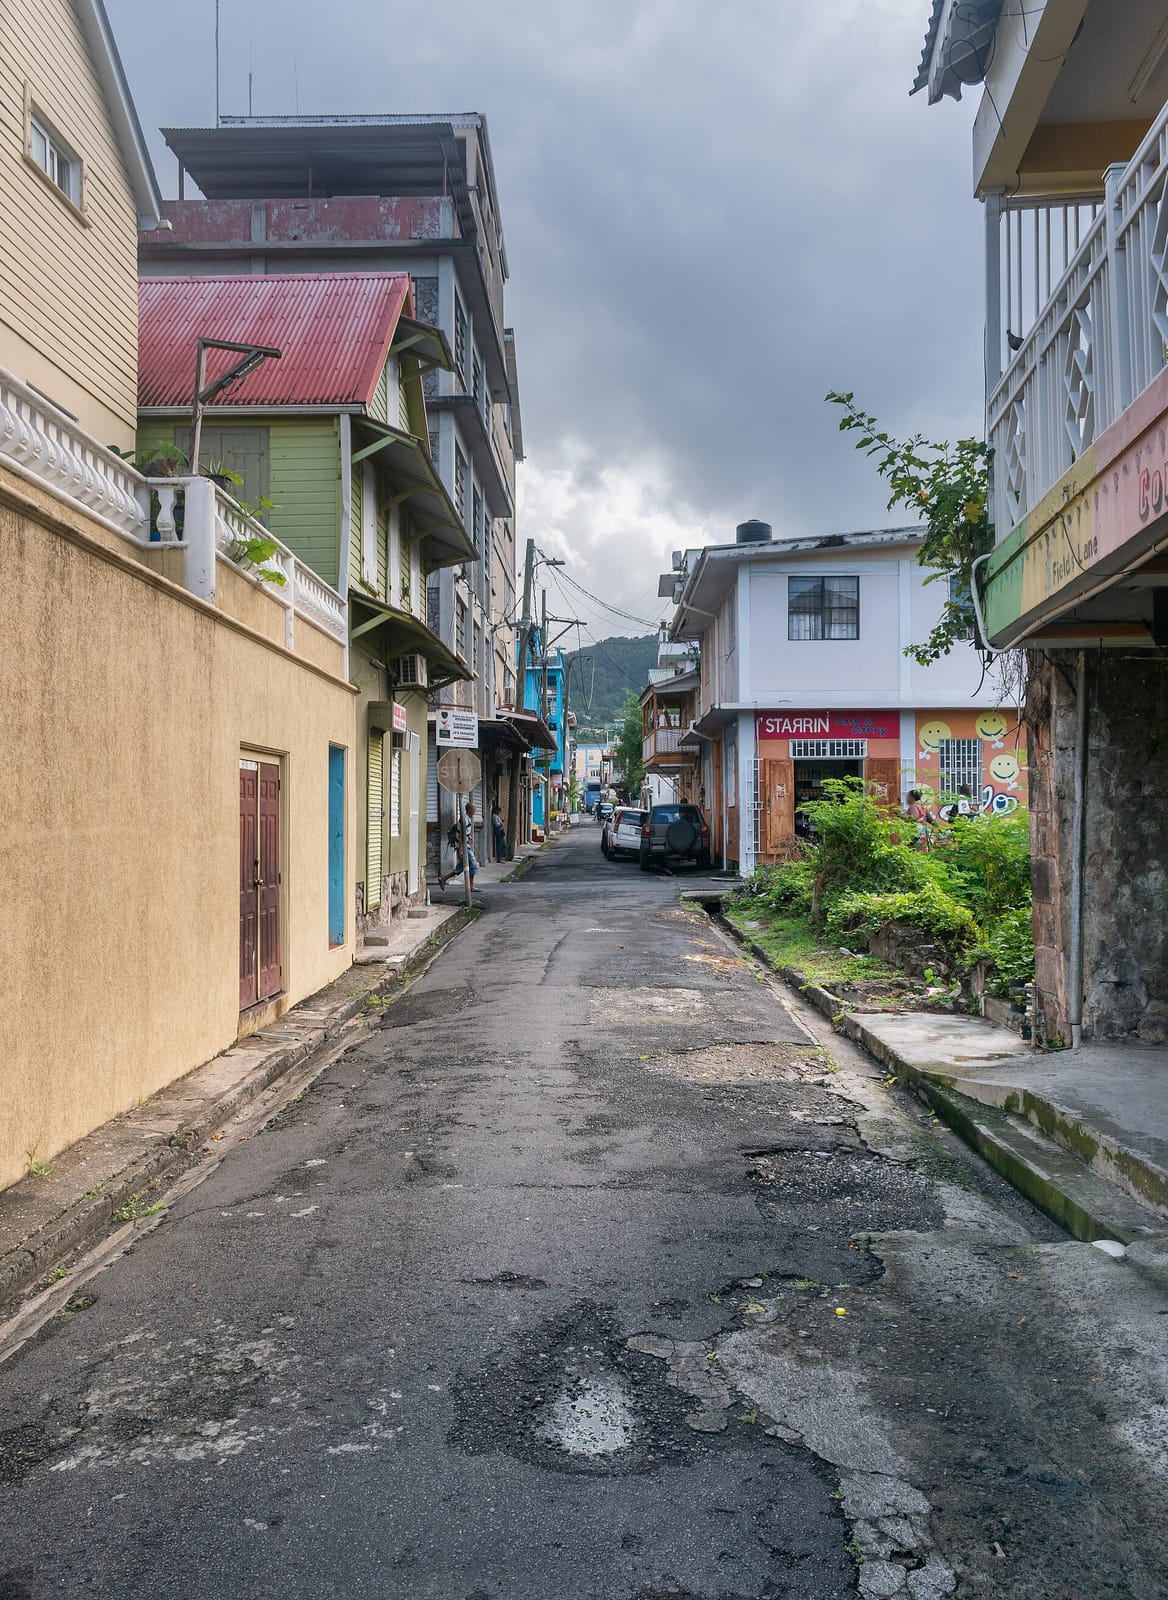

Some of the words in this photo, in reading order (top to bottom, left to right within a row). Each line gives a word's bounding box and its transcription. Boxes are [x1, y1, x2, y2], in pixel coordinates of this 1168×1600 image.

[1139, 461, 1168, 522] CO
[1077, 536, 1098, 565] Lane
[851, 725, 887, 737] Carry
[440, 765, 479, 778] STOP
